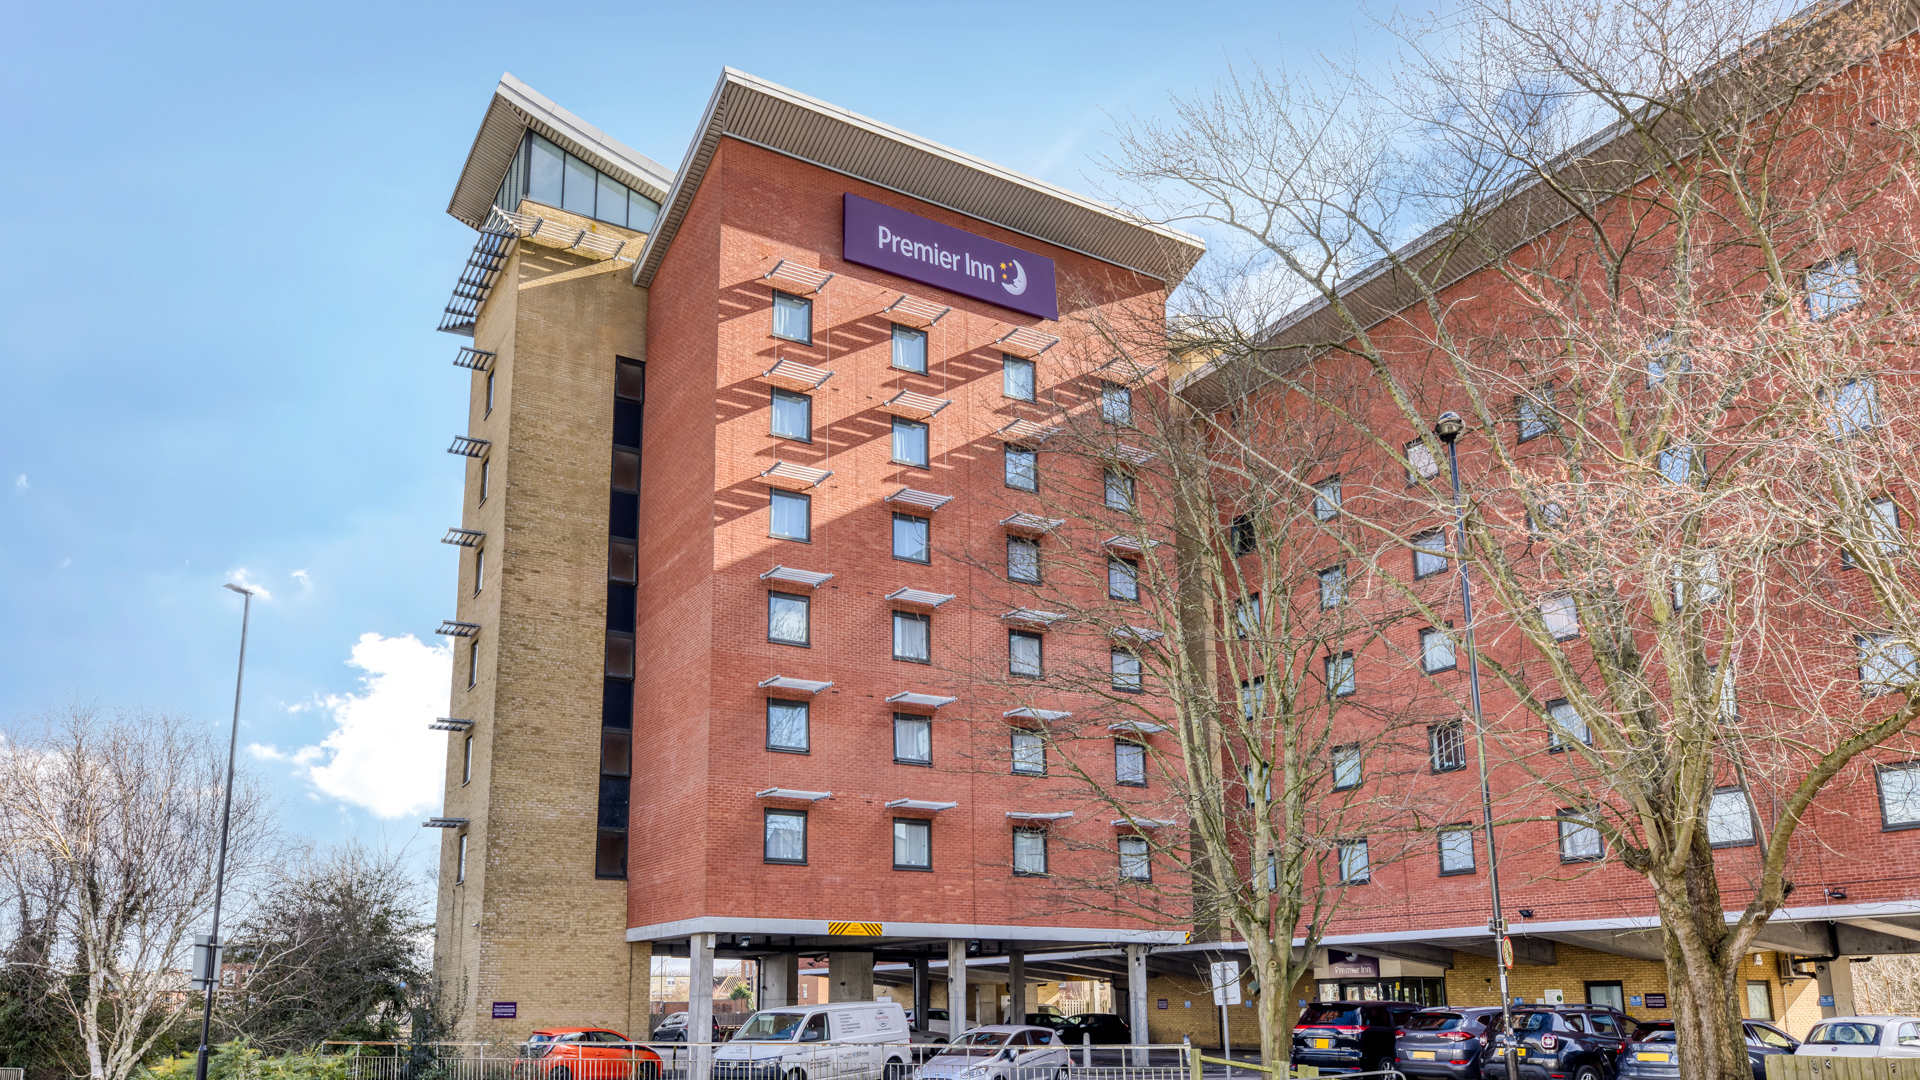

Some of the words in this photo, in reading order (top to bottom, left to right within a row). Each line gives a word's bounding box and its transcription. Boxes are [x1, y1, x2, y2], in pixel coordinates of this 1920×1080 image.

[878, 225, 960, 271] Premier
[965, 252, 995, 283] Inn
[1334, 965, 1360, 974] Premier
[1360, 965, 1372, 974] Inn
